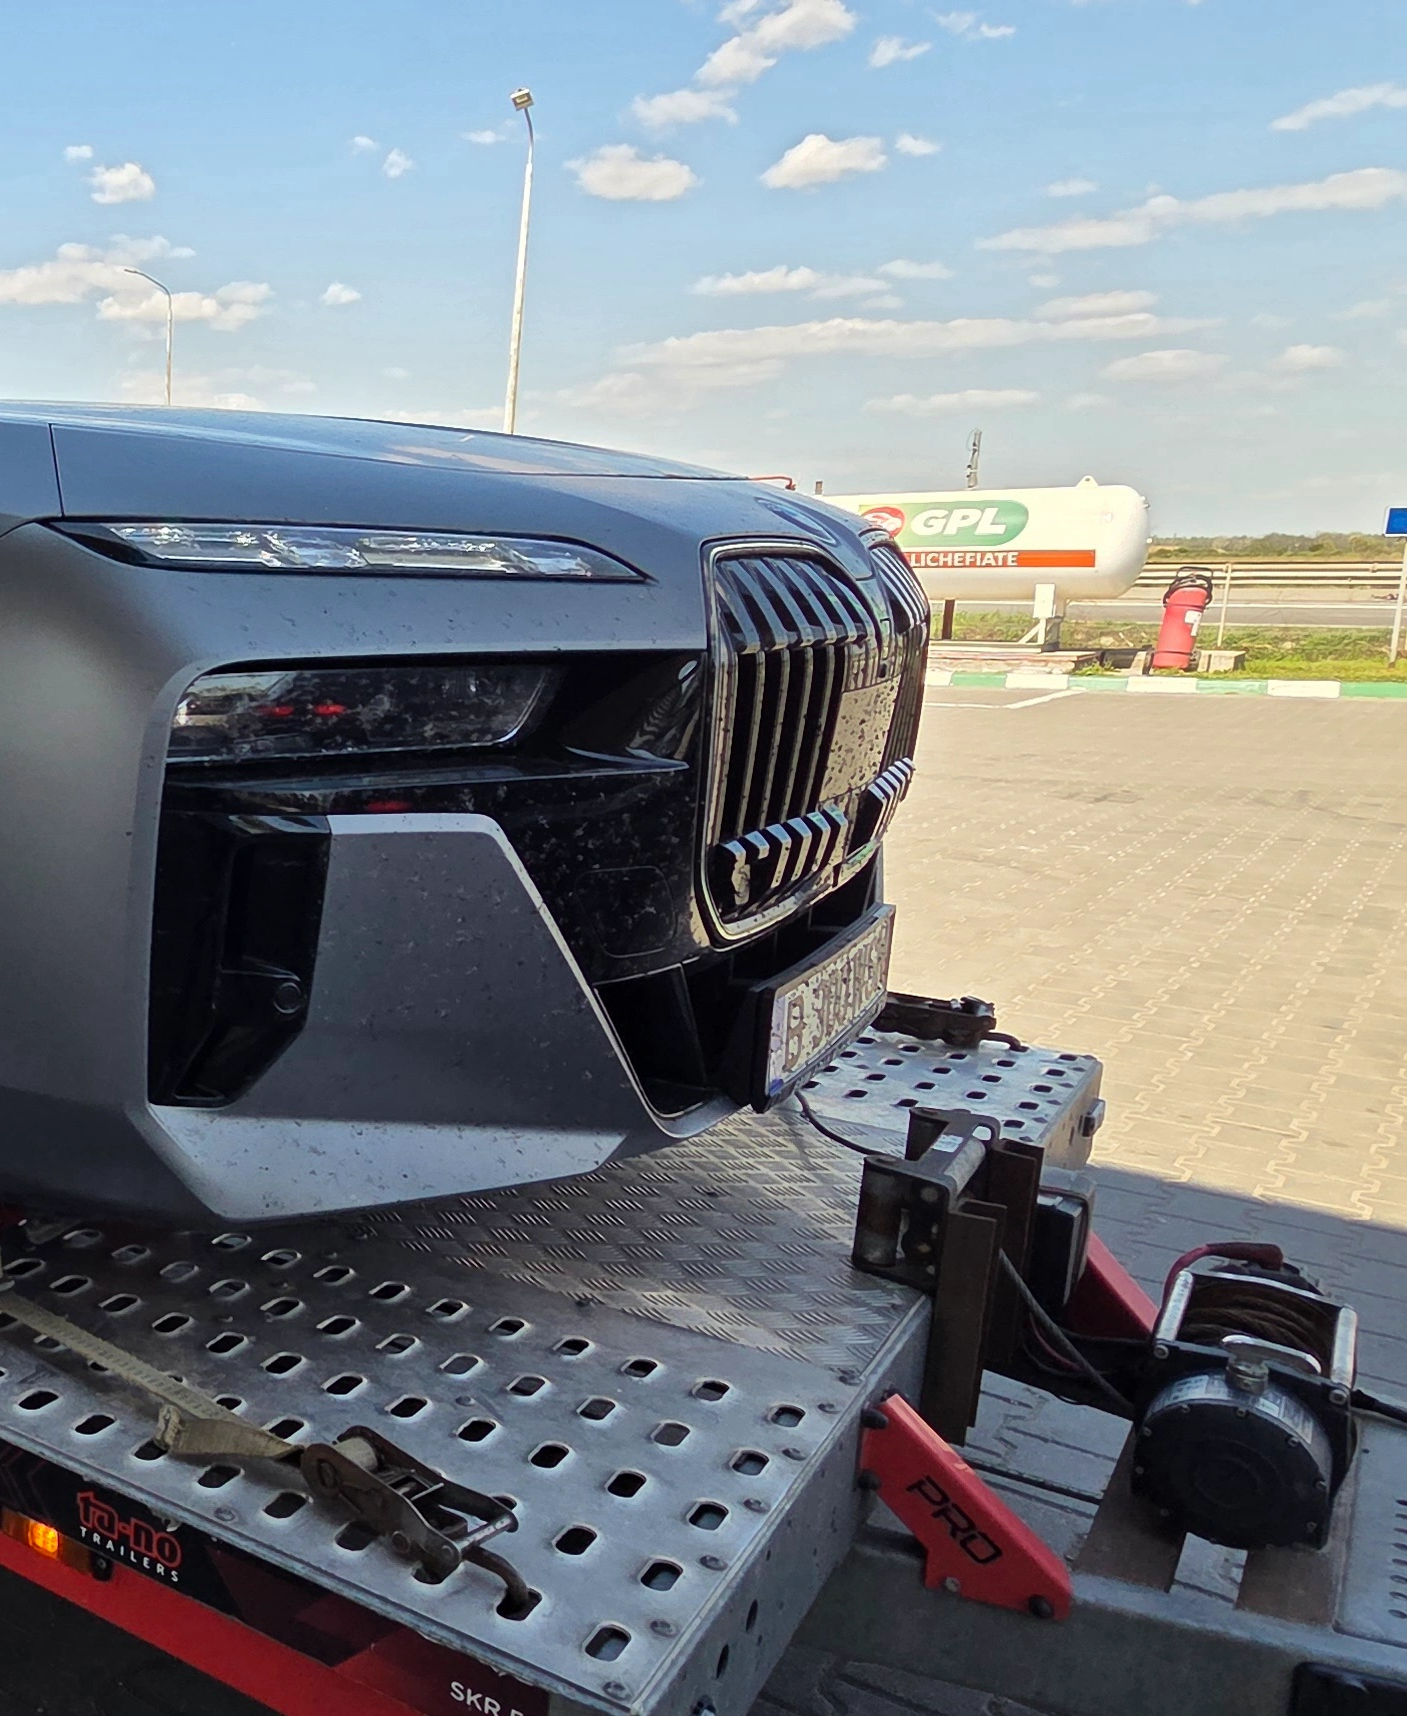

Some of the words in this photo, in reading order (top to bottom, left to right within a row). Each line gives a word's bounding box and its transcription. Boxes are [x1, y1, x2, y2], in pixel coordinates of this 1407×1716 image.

[910, 507, 1007, 536] GPL
[909, 551, 1019, 567] LICHEFIATE
[905, 1475, 1003, 1564] PRO
[80, 1526, 179, 1582] TRAILERS
[450, 1681, 501, 1716] SKR
